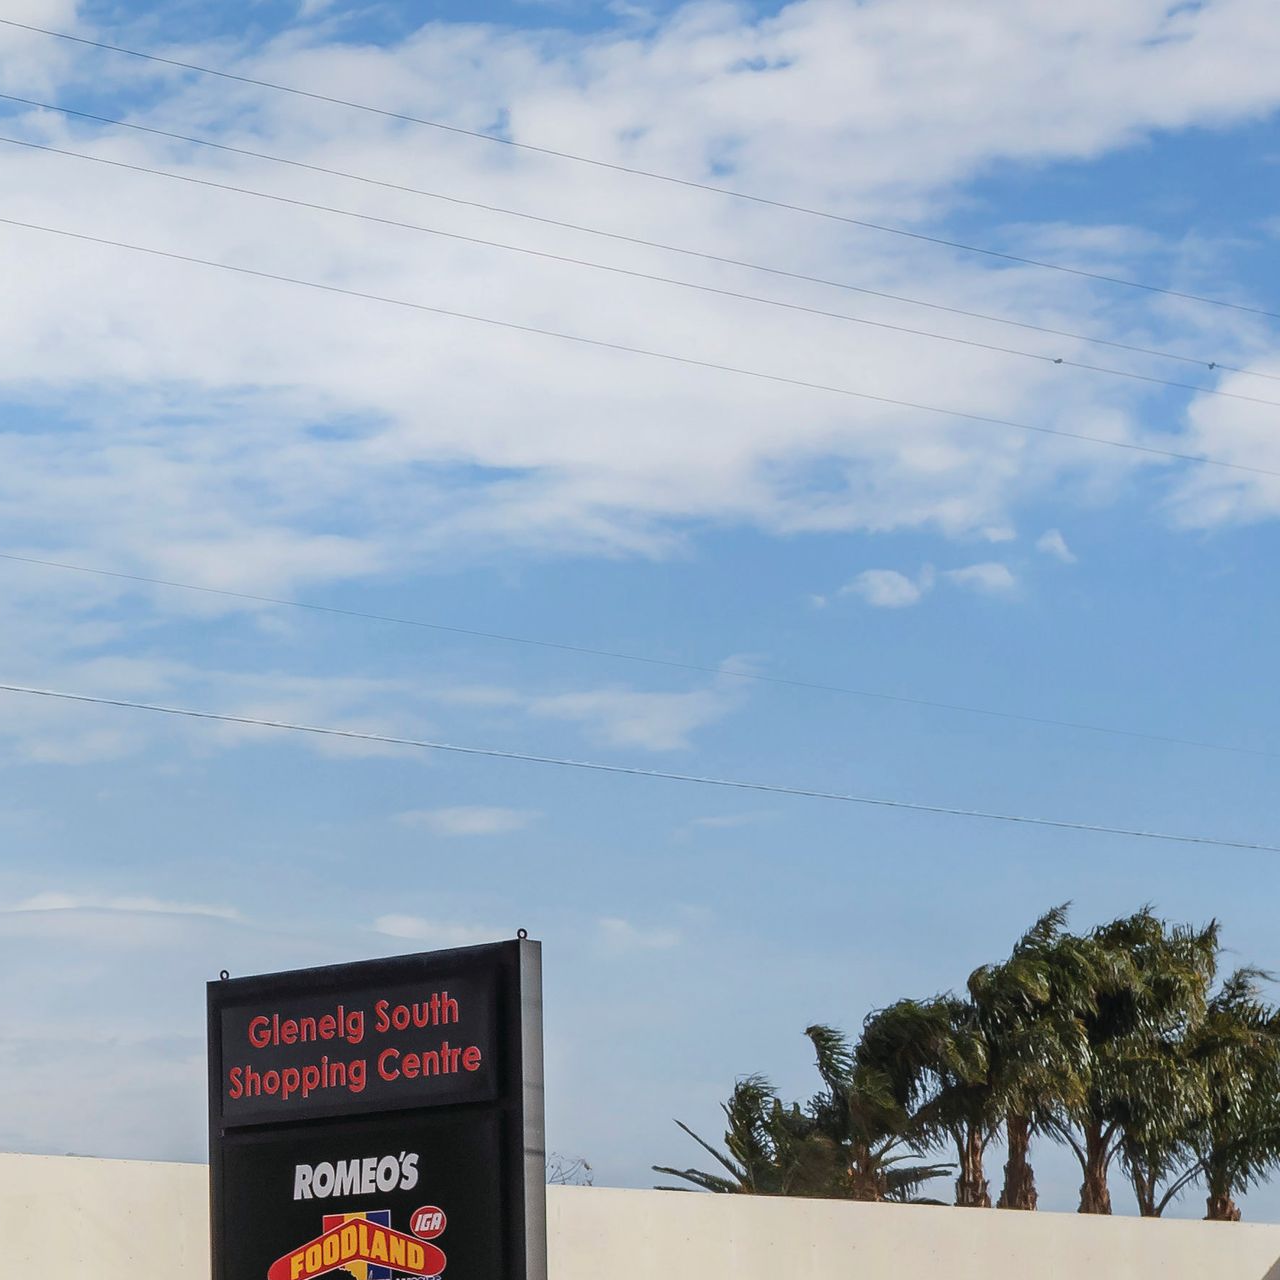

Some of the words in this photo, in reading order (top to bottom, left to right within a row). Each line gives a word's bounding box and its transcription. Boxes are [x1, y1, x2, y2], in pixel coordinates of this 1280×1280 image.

[248, 1005, 364, 1048] Glenelg
[375, 991, 458, 1032] South
[229, 1055, 367, 1100] Shopping
[377, 1041, 481, 1081] Centre
[293, 1151, 419, 1200] ROMEO'S
[414, 1213, 442, 1232] IGA
[290, 1224, 425, 1280] FOODLAND
